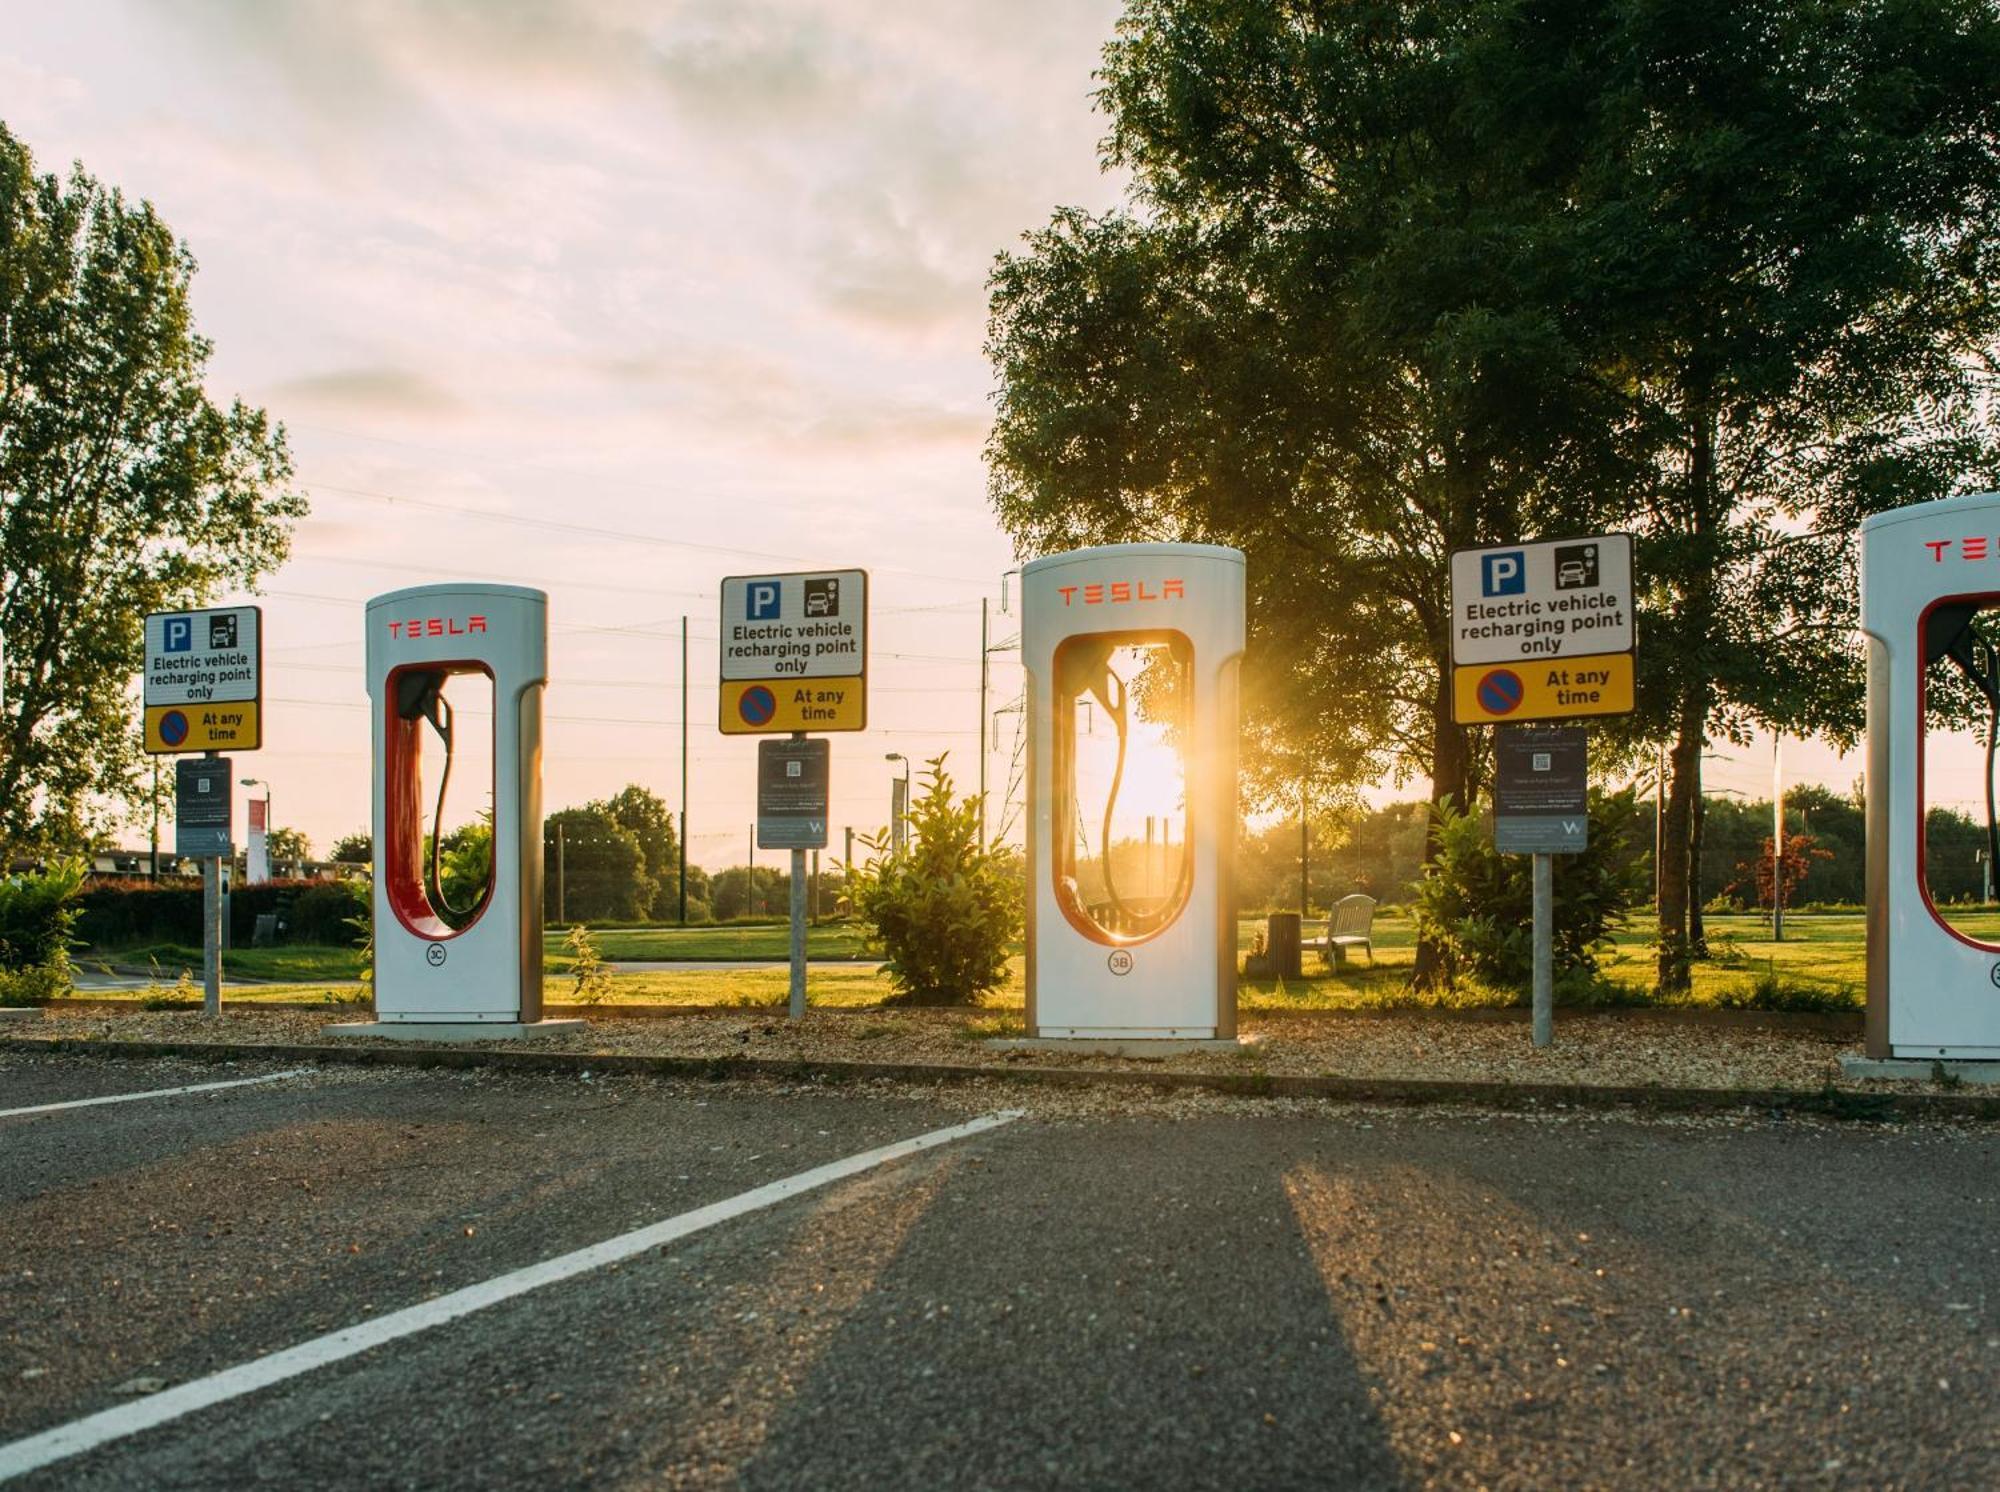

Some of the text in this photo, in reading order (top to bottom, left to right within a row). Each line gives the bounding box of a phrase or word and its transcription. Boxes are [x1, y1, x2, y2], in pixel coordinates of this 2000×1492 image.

[1925, 537, 2000, 562] TE
[1491, 558, 1517, 593] P
[755, 586, 775, 617] P
[1057, 579, 1184, 607] TESLA
[1467, 592, 1617, 620] Electric vehicle
[388, 616, 486, 640] TESLA
[734, 622, 851, 640] Electric vehicle
[1461, 611, 1623, 639] recharging point
[170, 622, 186, 649] P
[729, 639, 856, 659] recharging point
[1521, 637, 1562, 654] only
[154, 653, 248, 670] Electric vehicle
[775, 658, 807, 673] only
[150, 668, 251, 685] recharging point
[1547, 670, 1610, 686] At any
[187, 686, 213, 700] only
[794, 689, 844, 704] At any
[1557, 690, 1600, 705] time
[203, 713, 243, 726] At any
[802, 706, 836, 720] time
[209, 728, 236, 740] time
[430, 950, 442, 960] 3C
